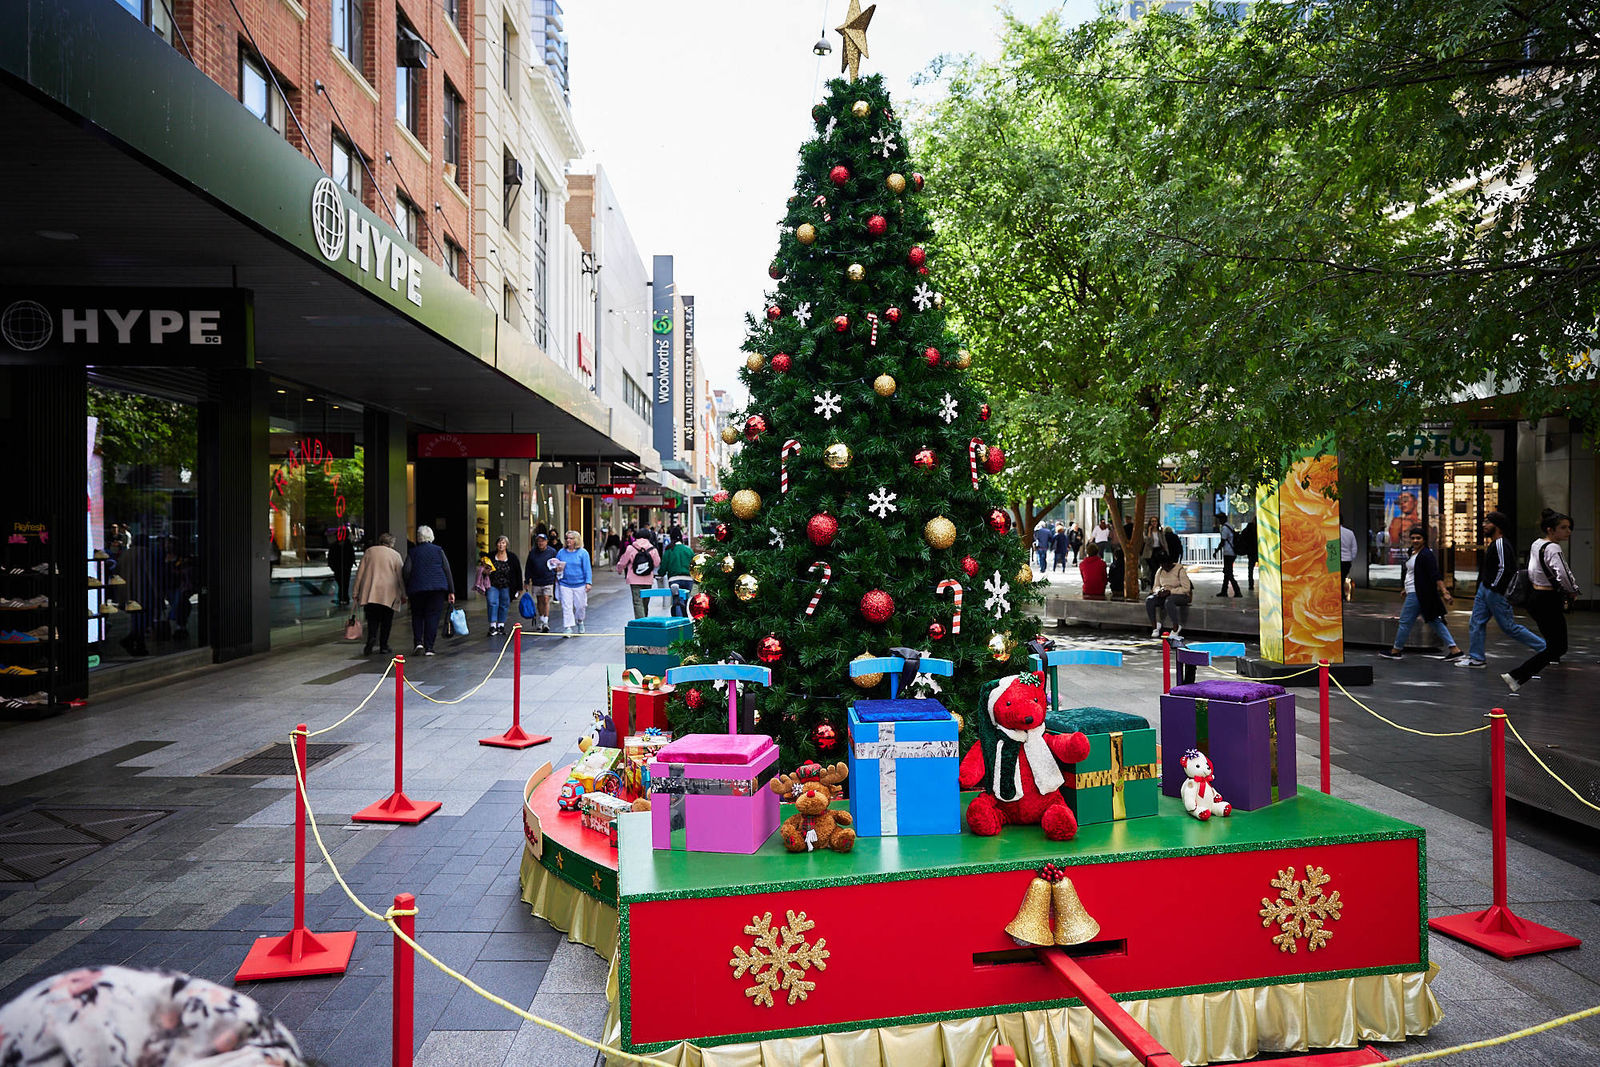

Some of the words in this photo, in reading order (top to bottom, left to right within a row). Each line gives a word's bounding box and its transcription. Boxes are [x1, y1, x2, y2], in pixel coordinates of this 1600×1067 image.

[347, 208, 422, 308] HYPE
[62, 309, 222, 344] HYPE
[685, 305, 694, 340] PLAZA
[657, 340, 669, 404] Woolworths
[685, 342, 694, 388] CENTRAL
[685, 391, 694, 441] ADELAIDE
[577, 465, 596, 485] betts
